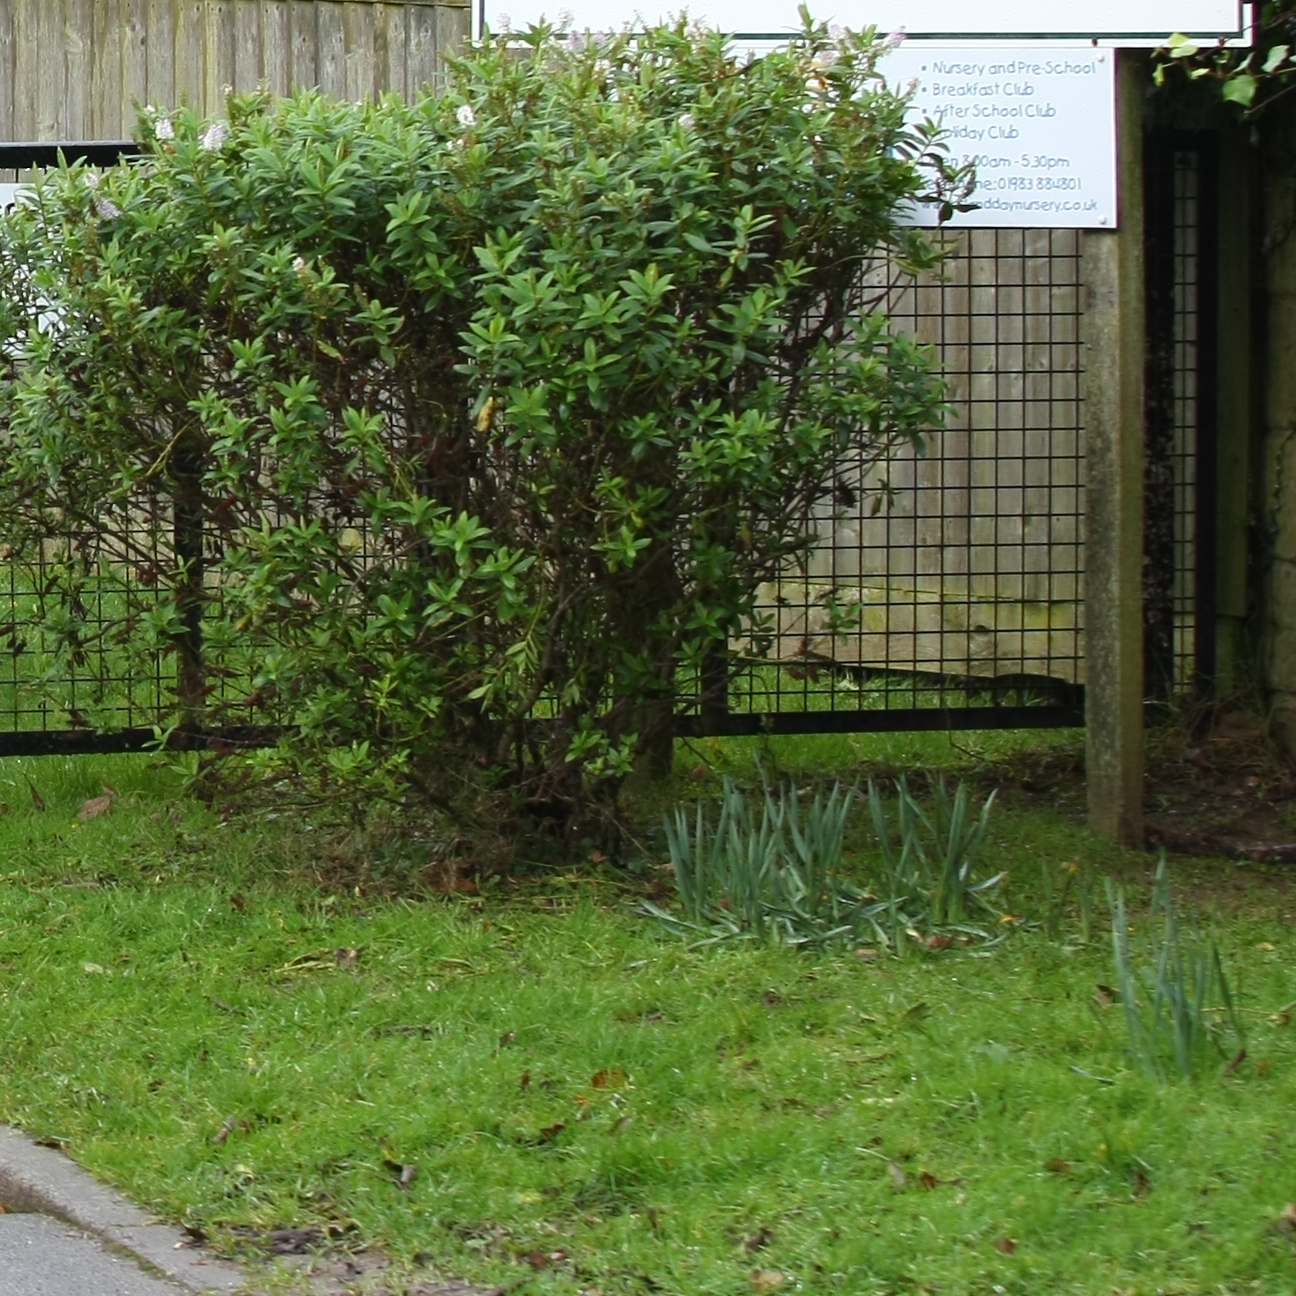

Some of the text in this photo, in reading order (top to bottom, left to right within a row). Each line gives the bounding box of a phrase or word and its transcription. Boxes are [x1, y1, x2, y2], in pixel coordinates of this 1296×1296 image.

[932, 61, 1096, 77] Nursery and Pre-School
[933, 81, 1035, 96] Breakfast Club
[933, 103, 1056, 118] After School Club
[988, 125, 1019, 140] Club
[1036, 177, 1082, 191] 884801
